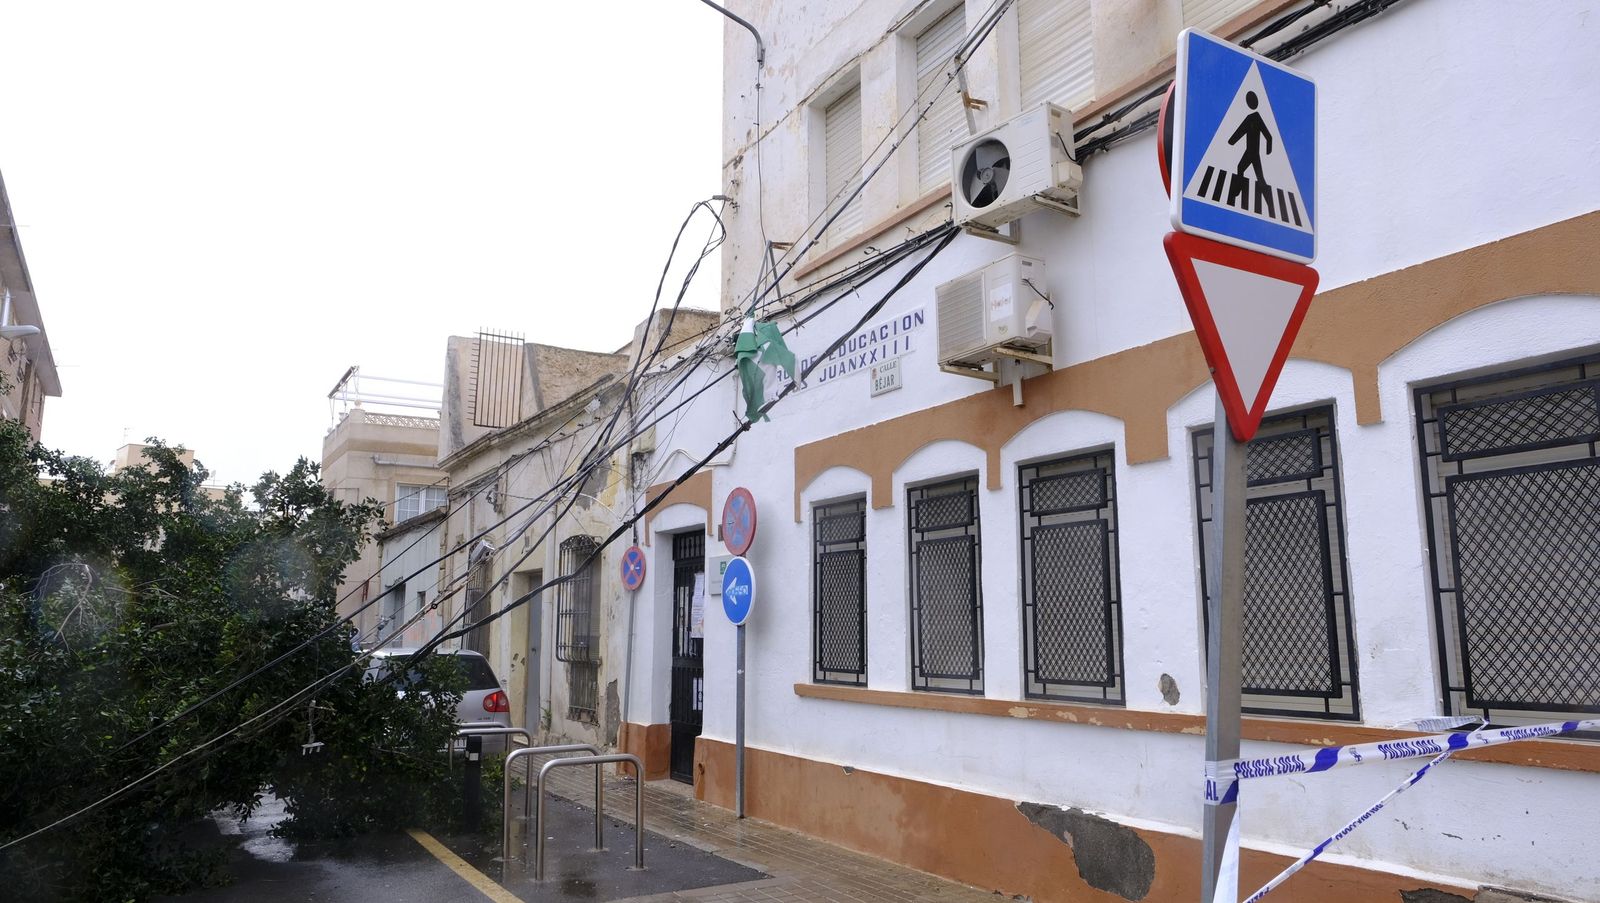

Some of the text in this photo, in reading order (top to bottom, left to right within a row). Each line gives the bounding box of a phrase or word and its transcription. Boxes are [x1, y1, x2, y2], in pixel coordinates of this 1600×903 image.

[879, 360, 897, 374] CALLE
[1378, 741, 1416, 760] POLICIA
[1411, 739, 1442, 756] LOCAL
[1233, 755, 1306, 780] POLICIA LOCAL
